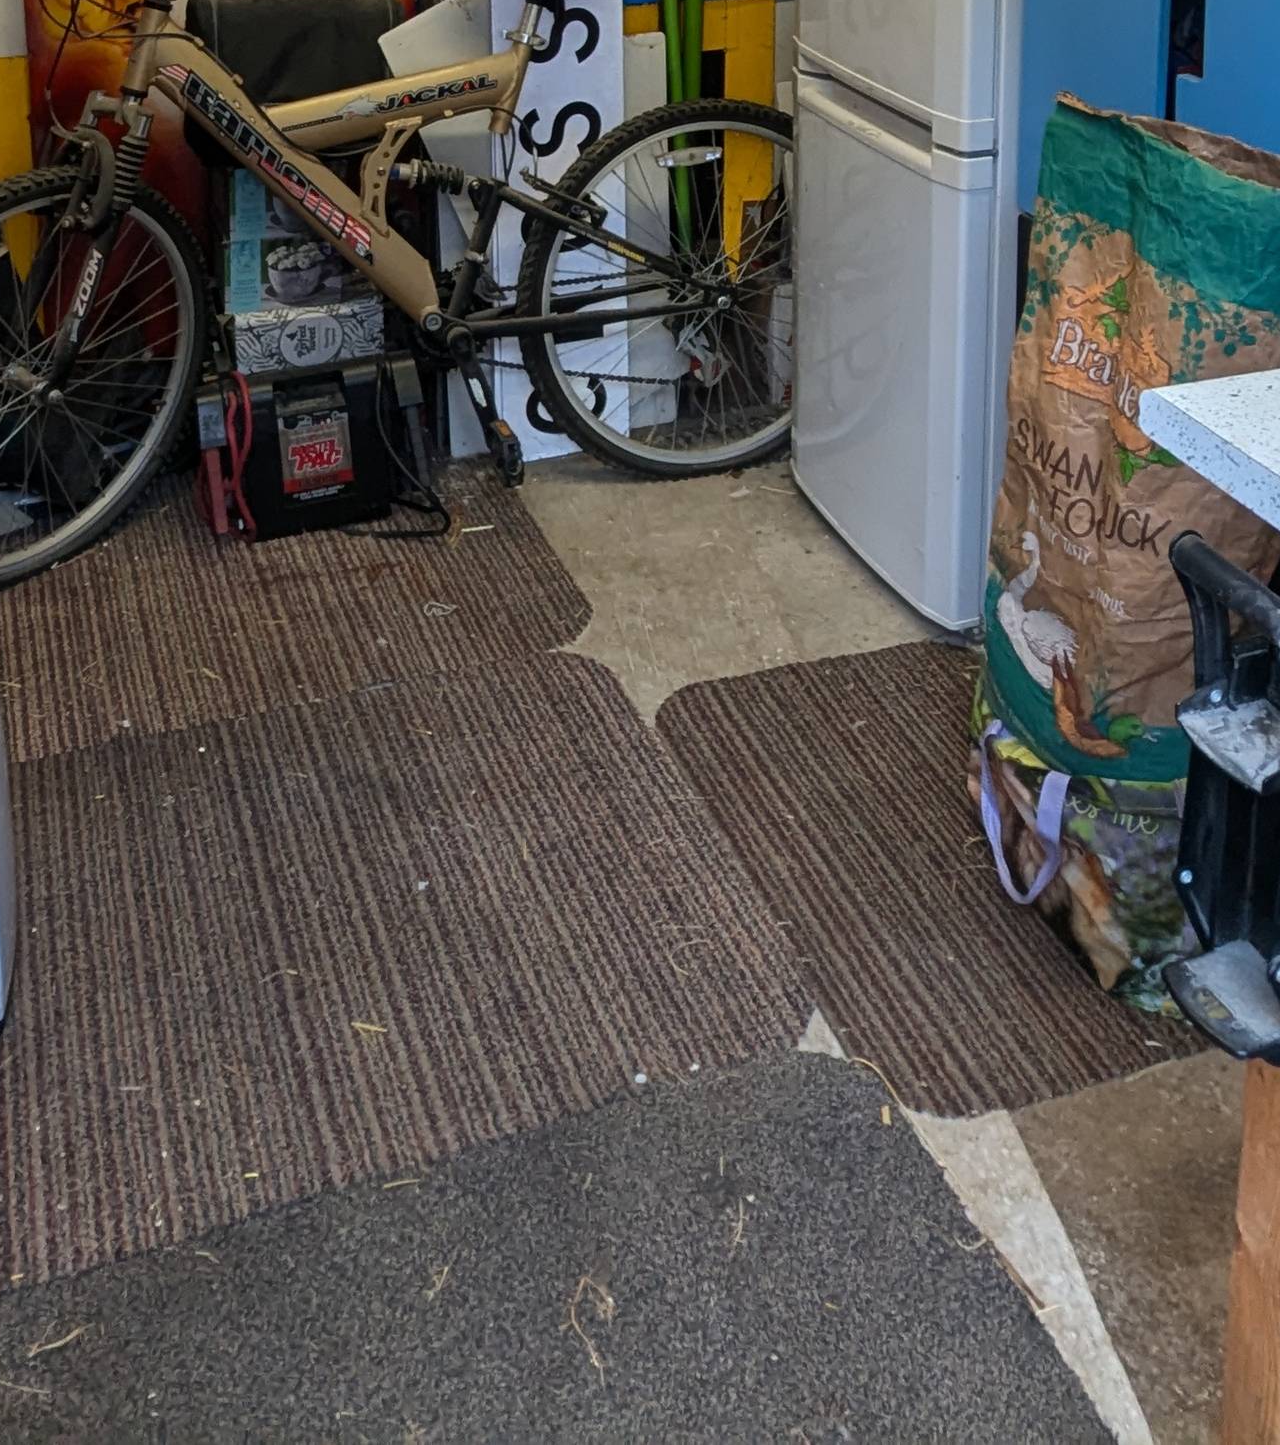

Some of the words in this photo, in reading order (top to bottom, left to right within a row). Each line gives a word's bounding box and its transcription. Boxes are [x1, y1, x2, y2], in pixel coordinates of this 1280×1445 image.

[378, 74, 498, 114] JACKAL
[73, 248, 103, 317] ZOOM
[1017, 418, 1103, 496] SWAN
